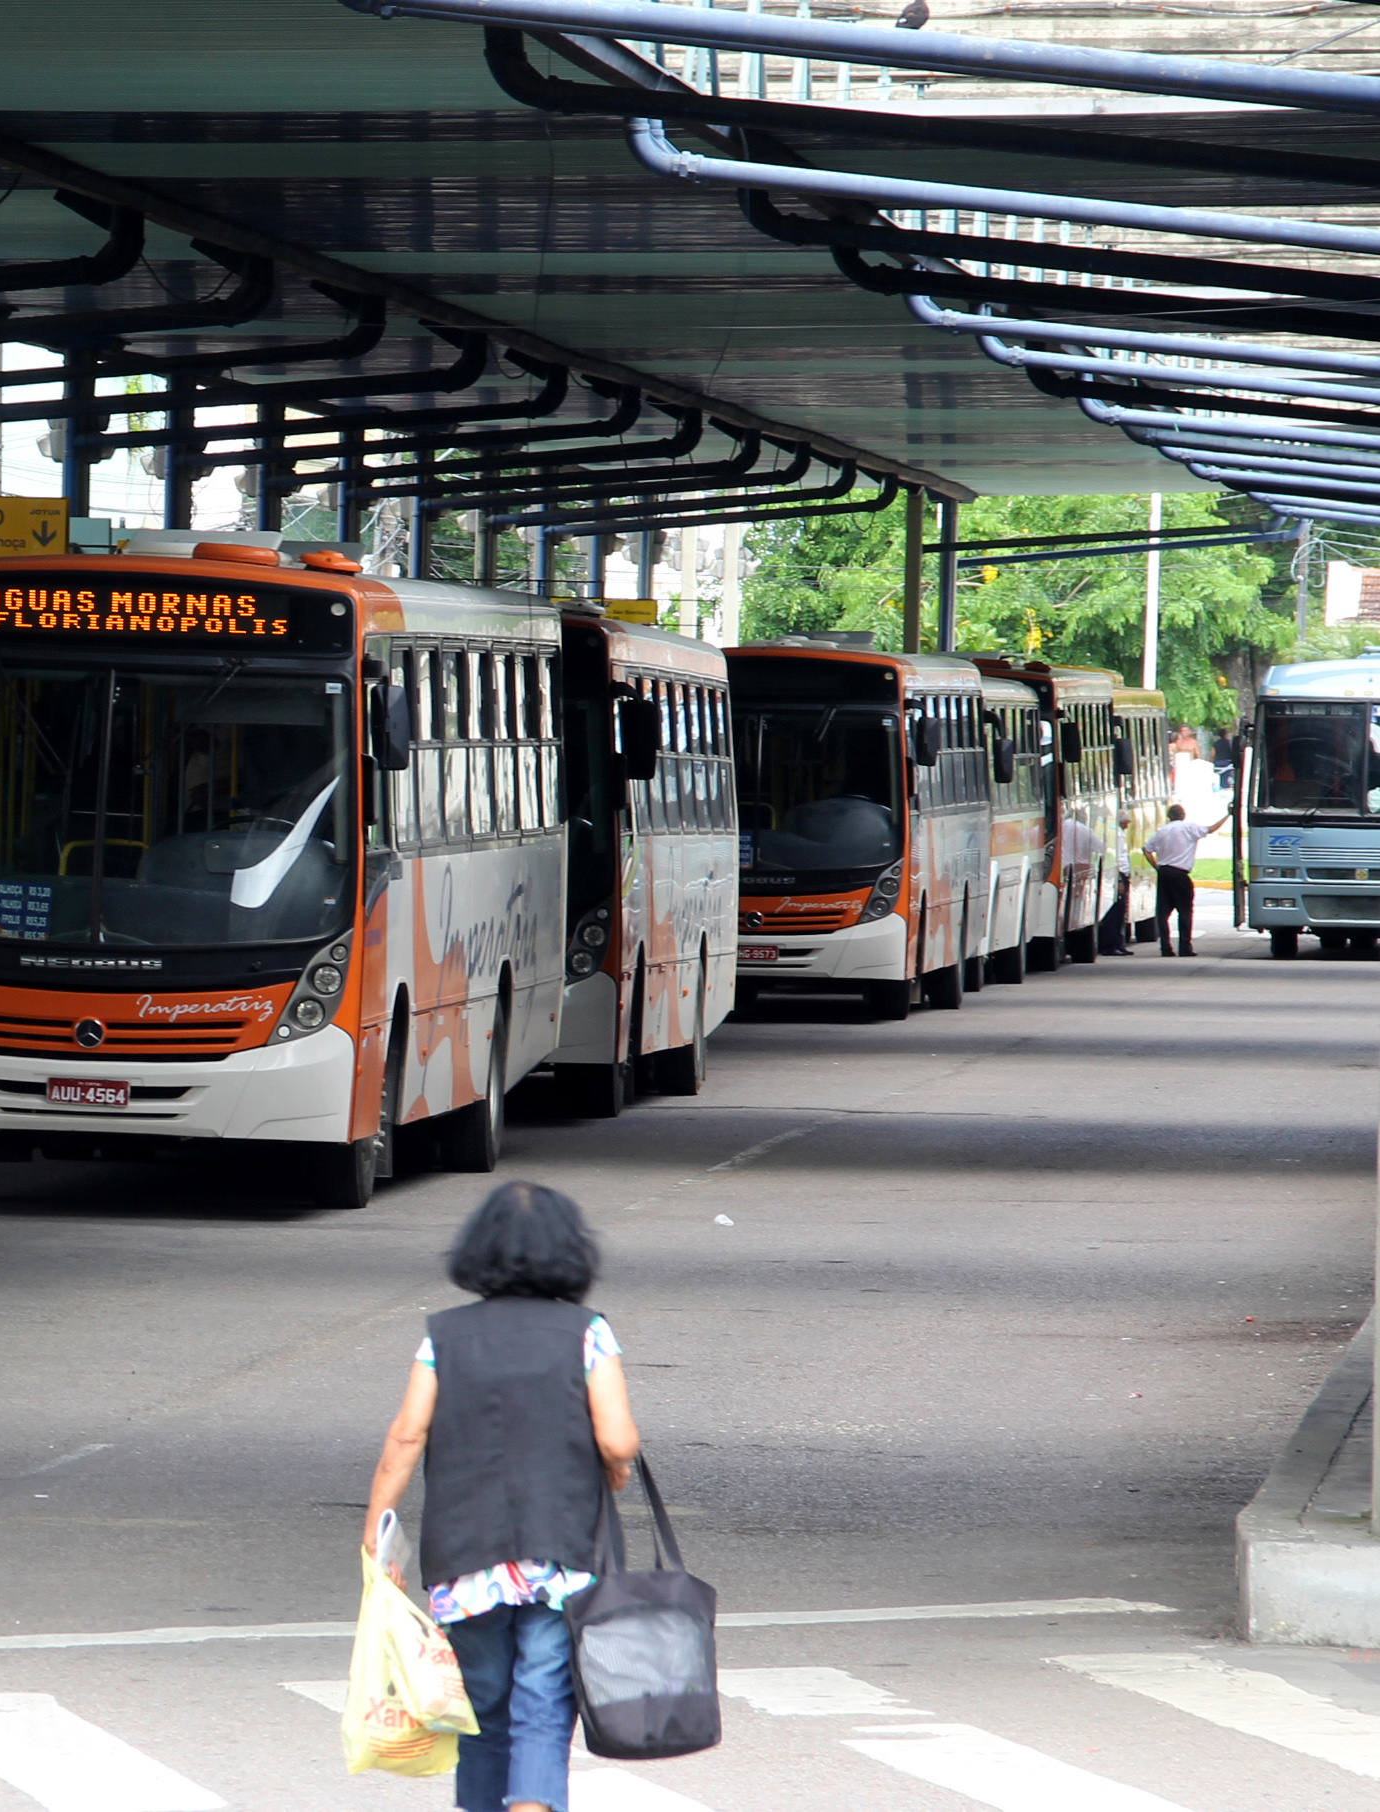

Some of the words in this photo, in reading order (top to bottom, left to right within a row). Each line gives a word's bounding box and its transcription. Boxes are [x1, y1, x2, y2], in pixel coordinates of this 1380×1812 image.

[111, 591, 256, 617] MORNAS
[774, 896, 864, 915] Imperatriz
[20, 955, 163, 970] NEOBUS
[135, 994, 274, 1022] Imperatriz
